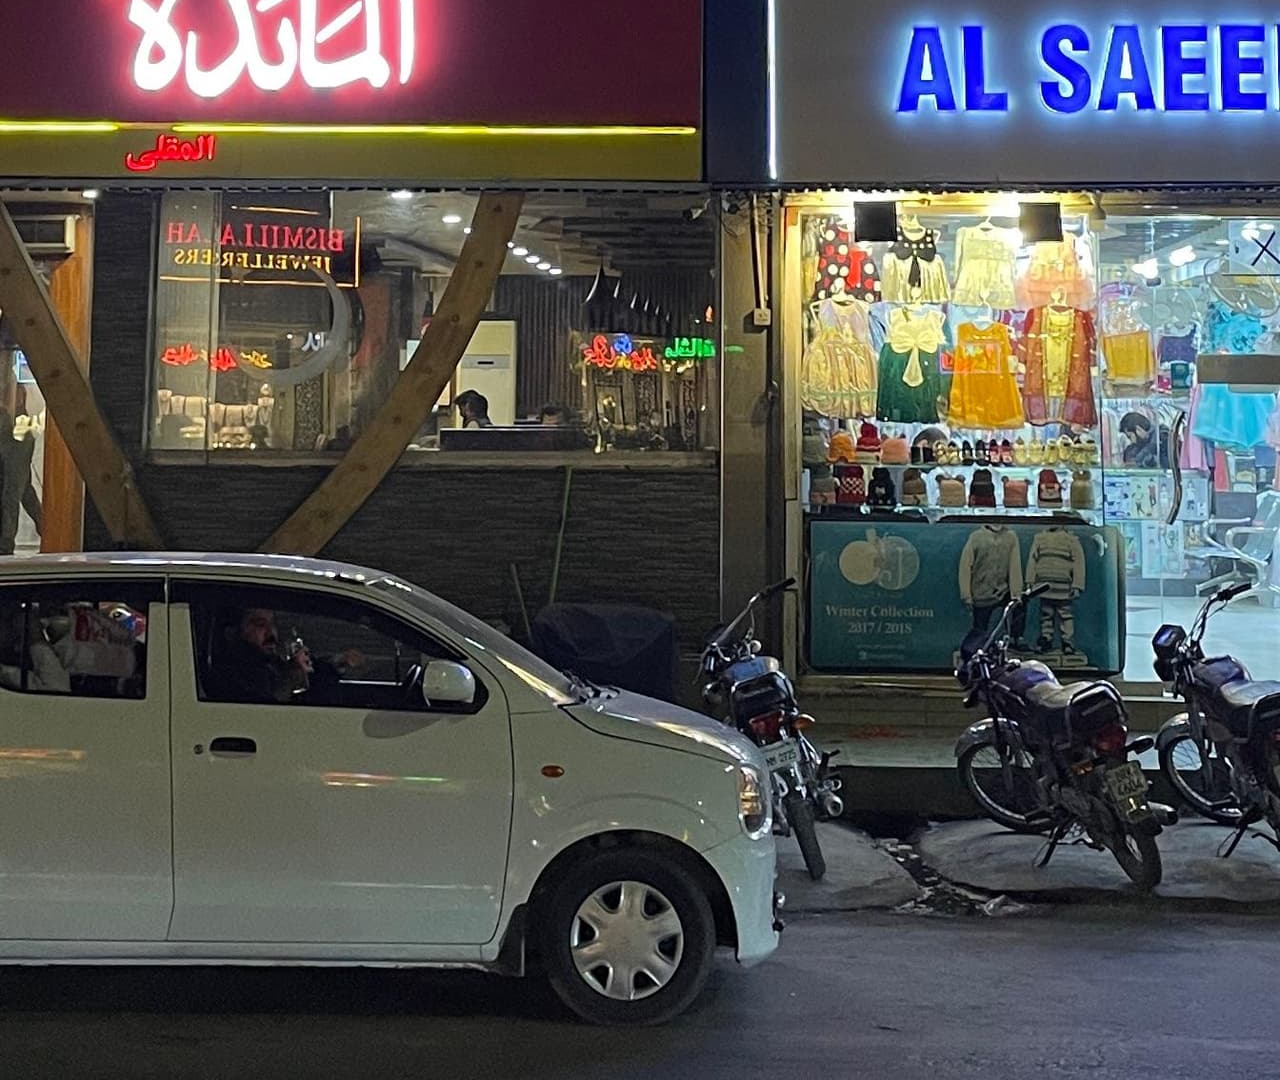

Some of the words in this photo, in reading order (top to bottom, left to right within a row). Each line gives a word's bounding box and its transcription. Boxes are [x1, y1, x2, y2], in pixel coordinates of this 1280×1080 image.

[896, 26, 1008, 112] AL
[825, 604, 869, 617] Winter
[871, 605, 934, 617] Collection
